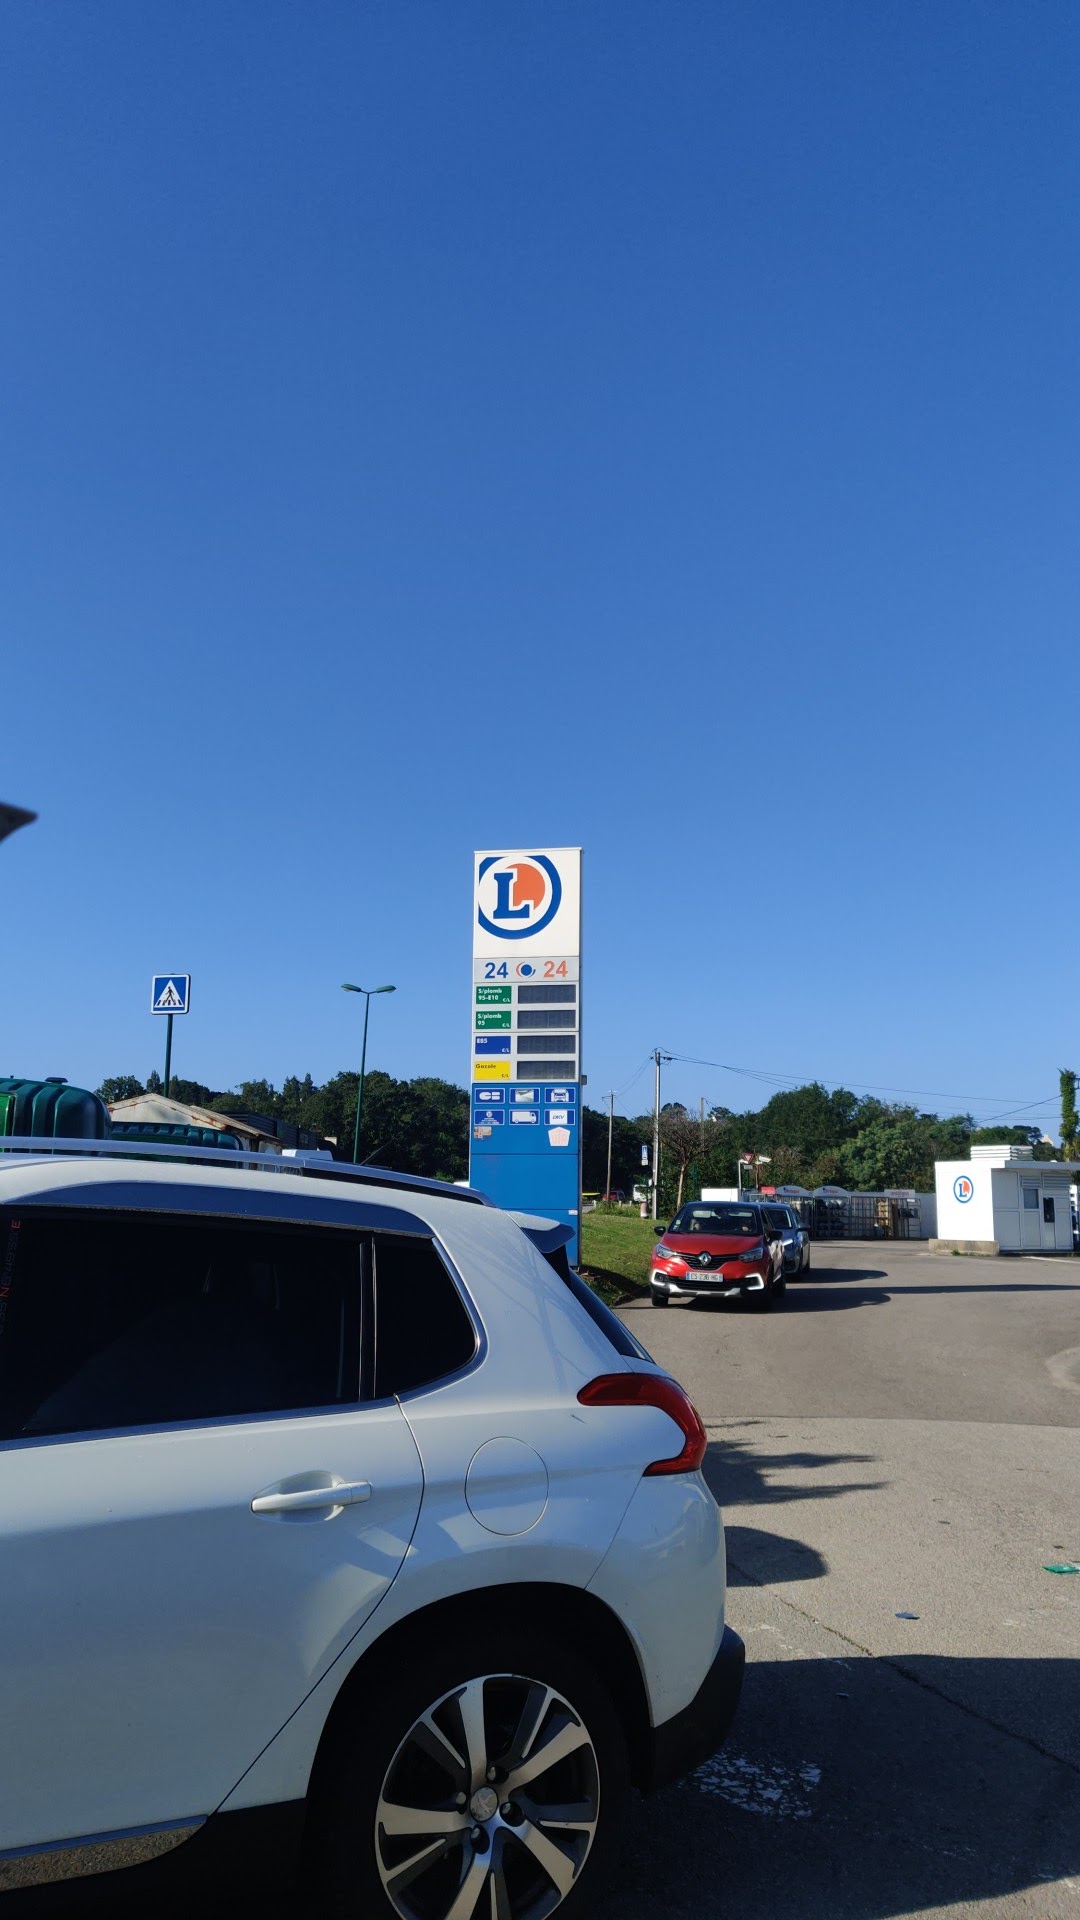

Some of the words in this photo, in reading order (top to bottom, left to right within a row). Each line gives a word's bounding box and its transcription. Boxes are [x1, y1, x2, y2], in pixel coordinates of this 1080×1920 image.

[493, 872, 530, 919] L
[484, 962, 509, 979] 24
[543, 960, 569, 978] 24
